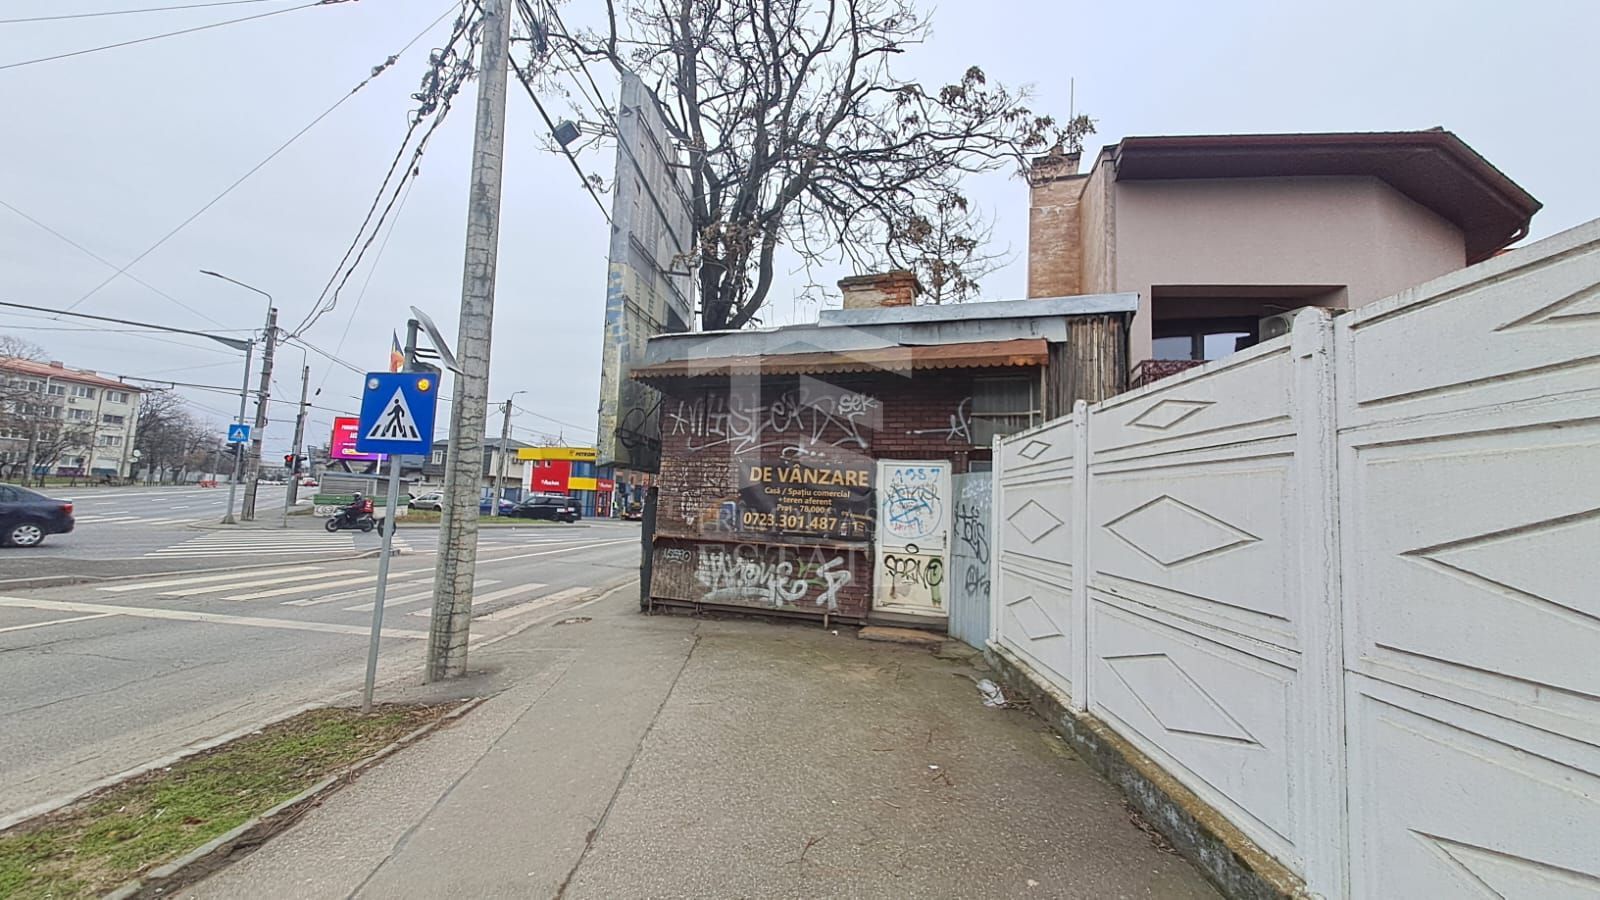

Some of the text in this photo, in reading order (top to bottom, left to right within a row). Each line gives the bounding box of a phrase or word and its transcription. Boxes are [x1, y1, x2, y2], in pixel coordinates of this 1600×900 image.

[749, 463, 870, 487] DE VÂNZARE
[804, 497, 833, 505] aferent
[812, 490, 851, 498] comercial
[743, 511, 838, 531] 0723.301.487
